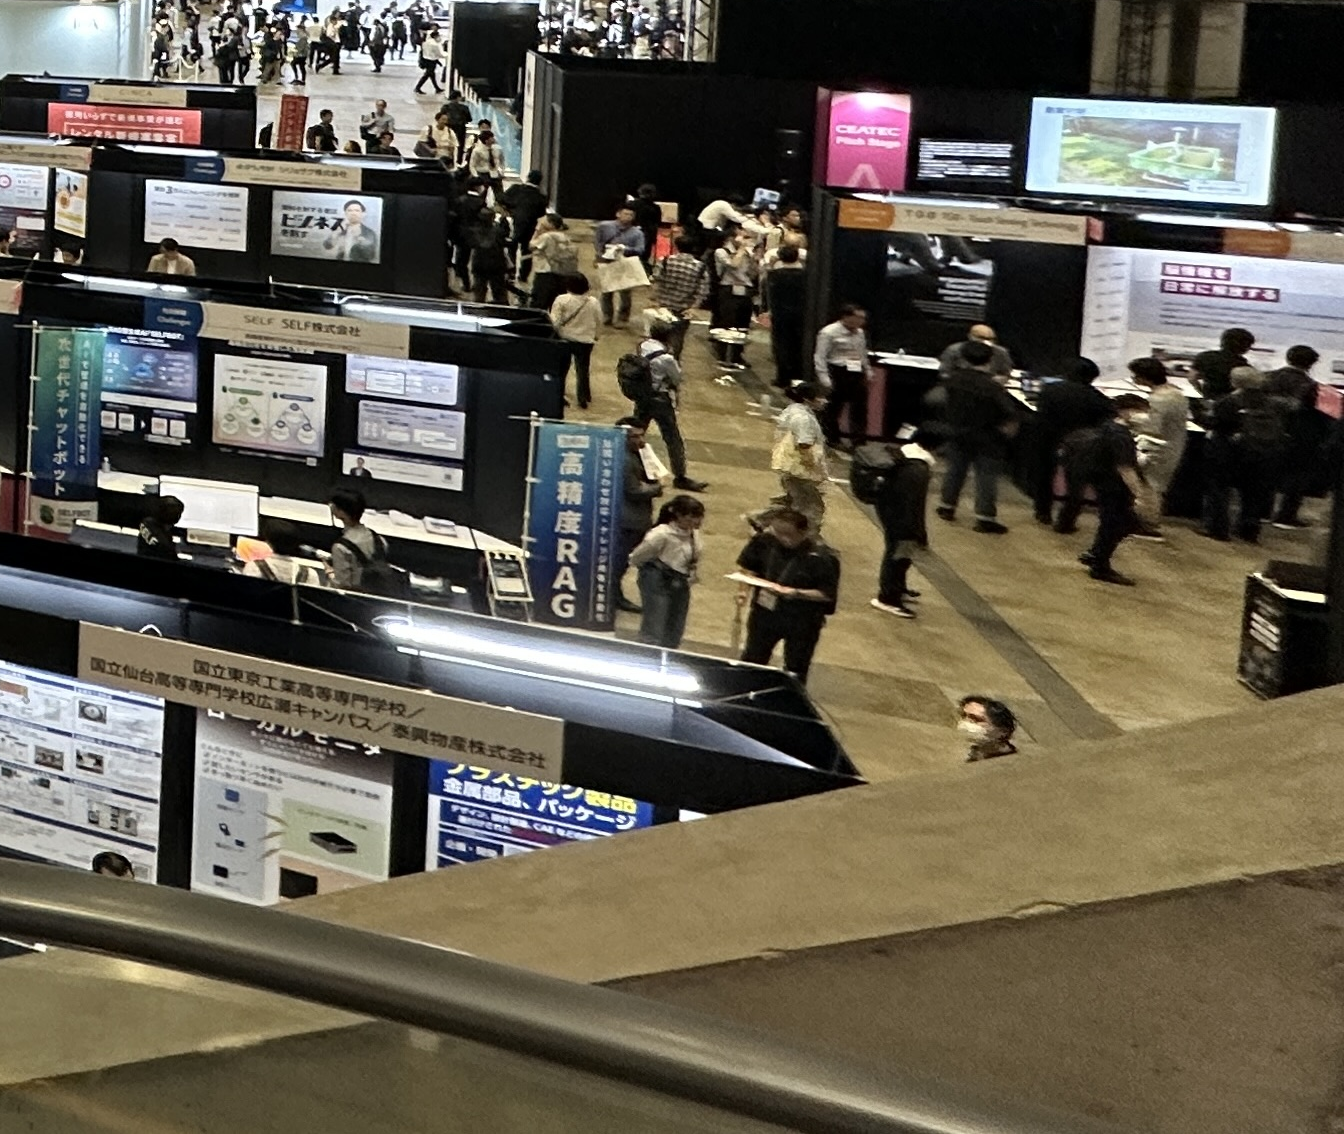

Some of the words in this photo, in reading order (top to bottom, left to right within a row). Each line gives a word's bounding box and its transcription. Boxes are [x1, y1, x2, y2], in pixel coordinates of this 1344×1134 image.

[835, 125, 901, 137] CEATEC
[281, 214, 347, 235] ビジネス
[244, 315, 275, 326] SELF
[281, 317, 361, 337] SELF株式会社
[53, 336, 72, 497] 次世代チャットボット
[551, 451, 585, 618] 高精度RAG
